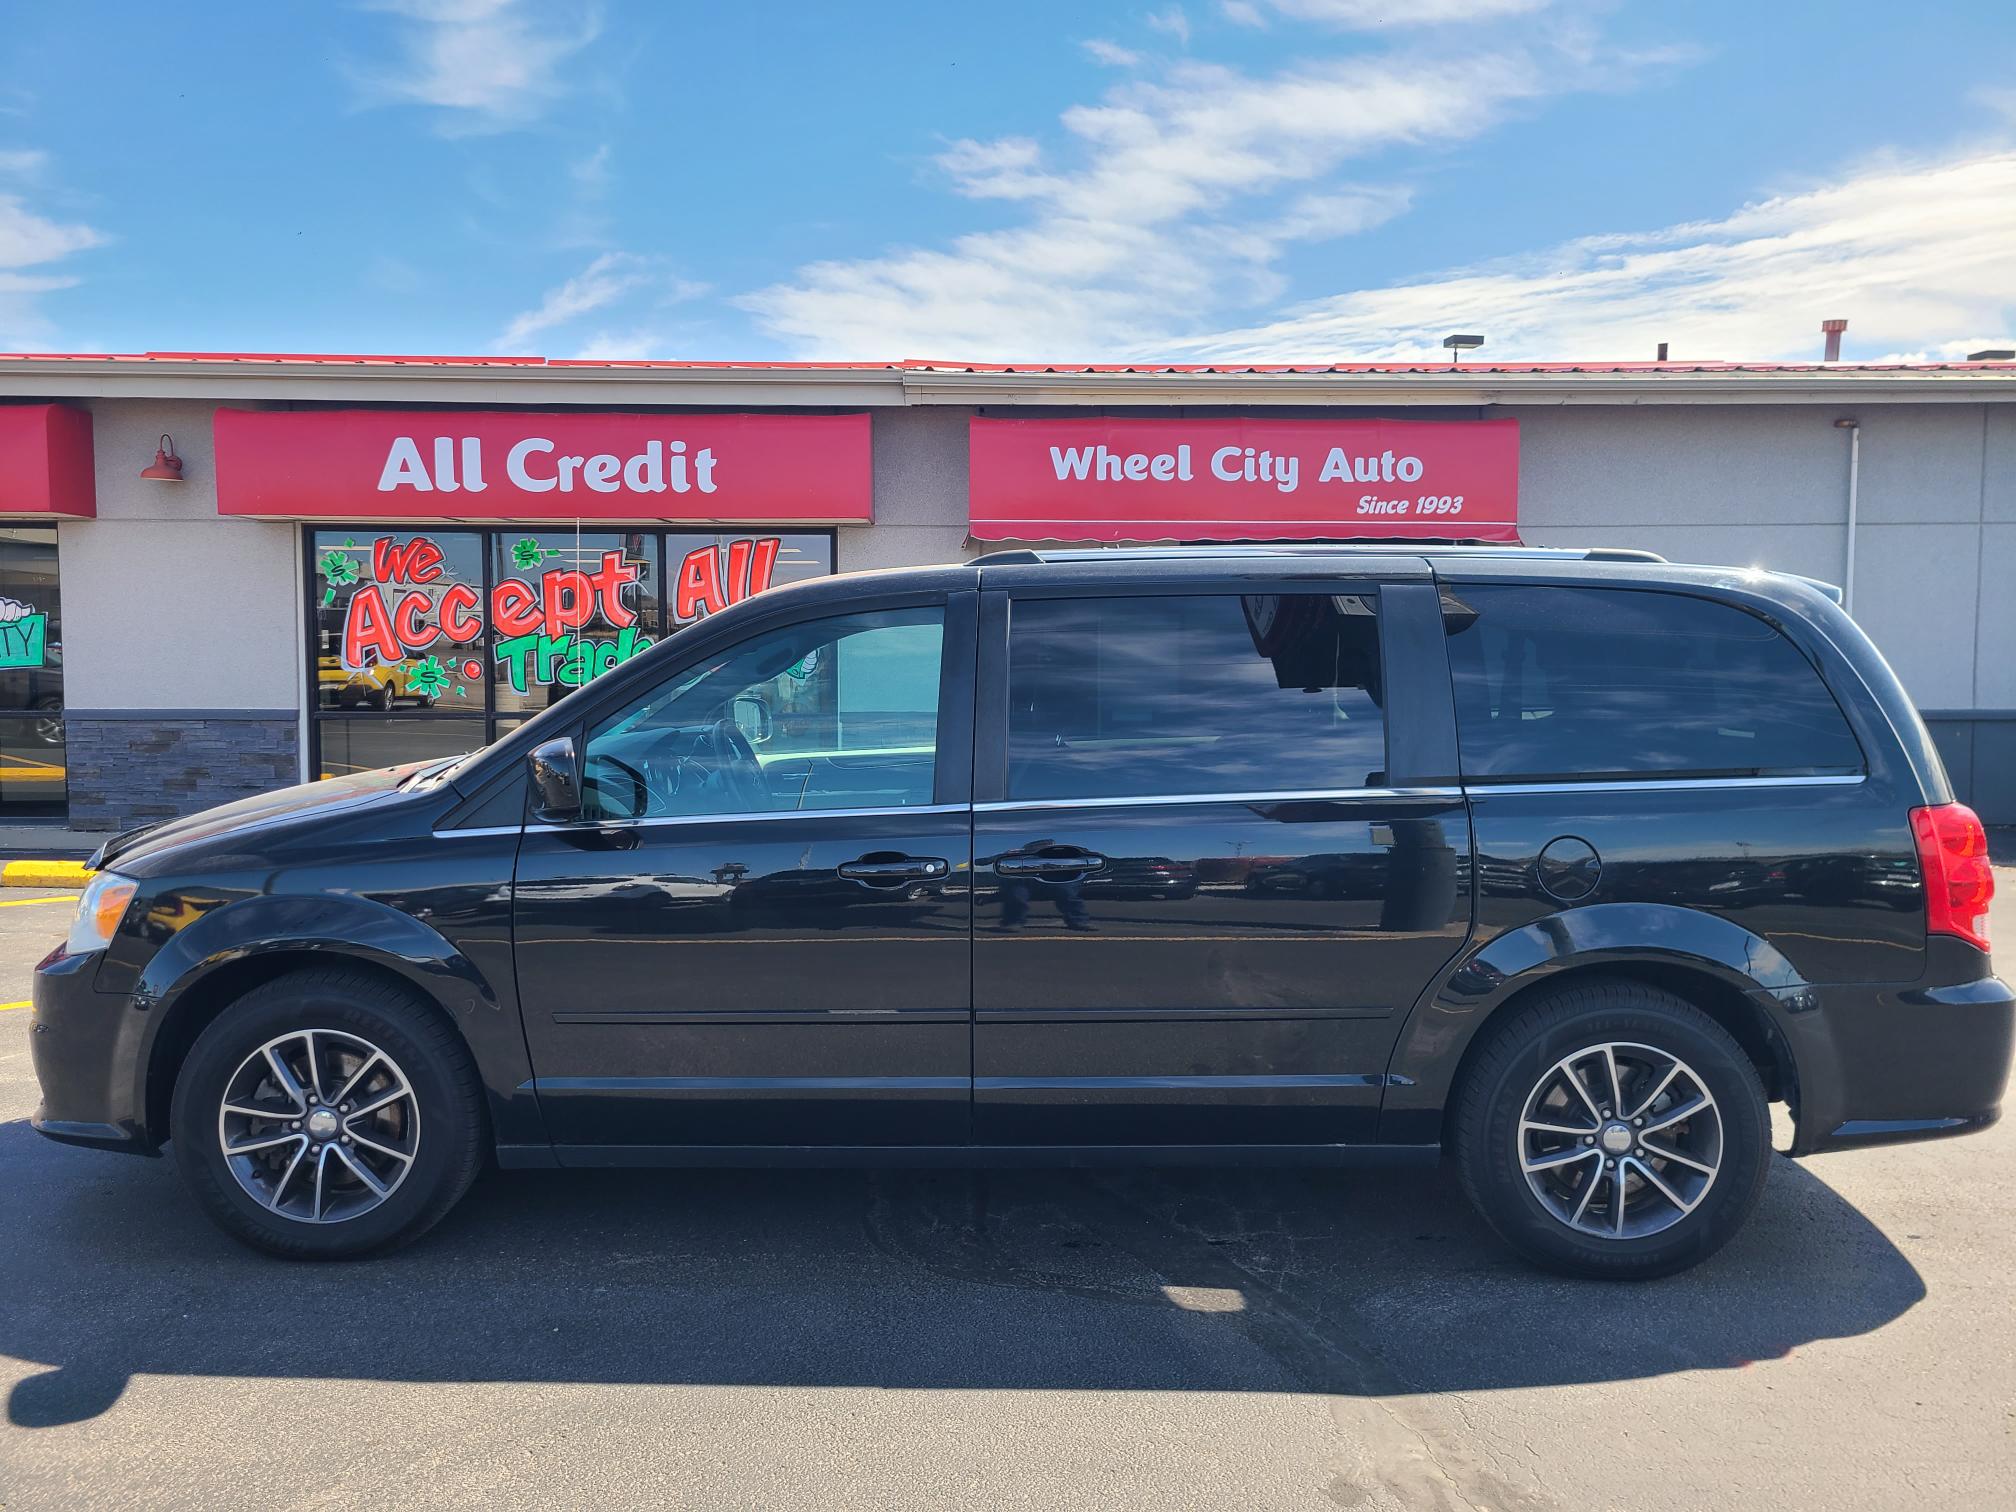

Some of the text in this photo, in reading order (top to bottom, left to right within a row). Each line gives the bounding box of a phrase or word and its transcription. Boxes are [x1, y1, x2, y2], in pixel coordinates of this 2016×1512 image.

[378, 436, 718, 494] All Credit
[1049, 444, 1424, 493] Wheel City Auto
[1357, 495, 1464, 514] Since 1993
[676, 536, 781, 622] All
[0, 621, 36, 657] TY
